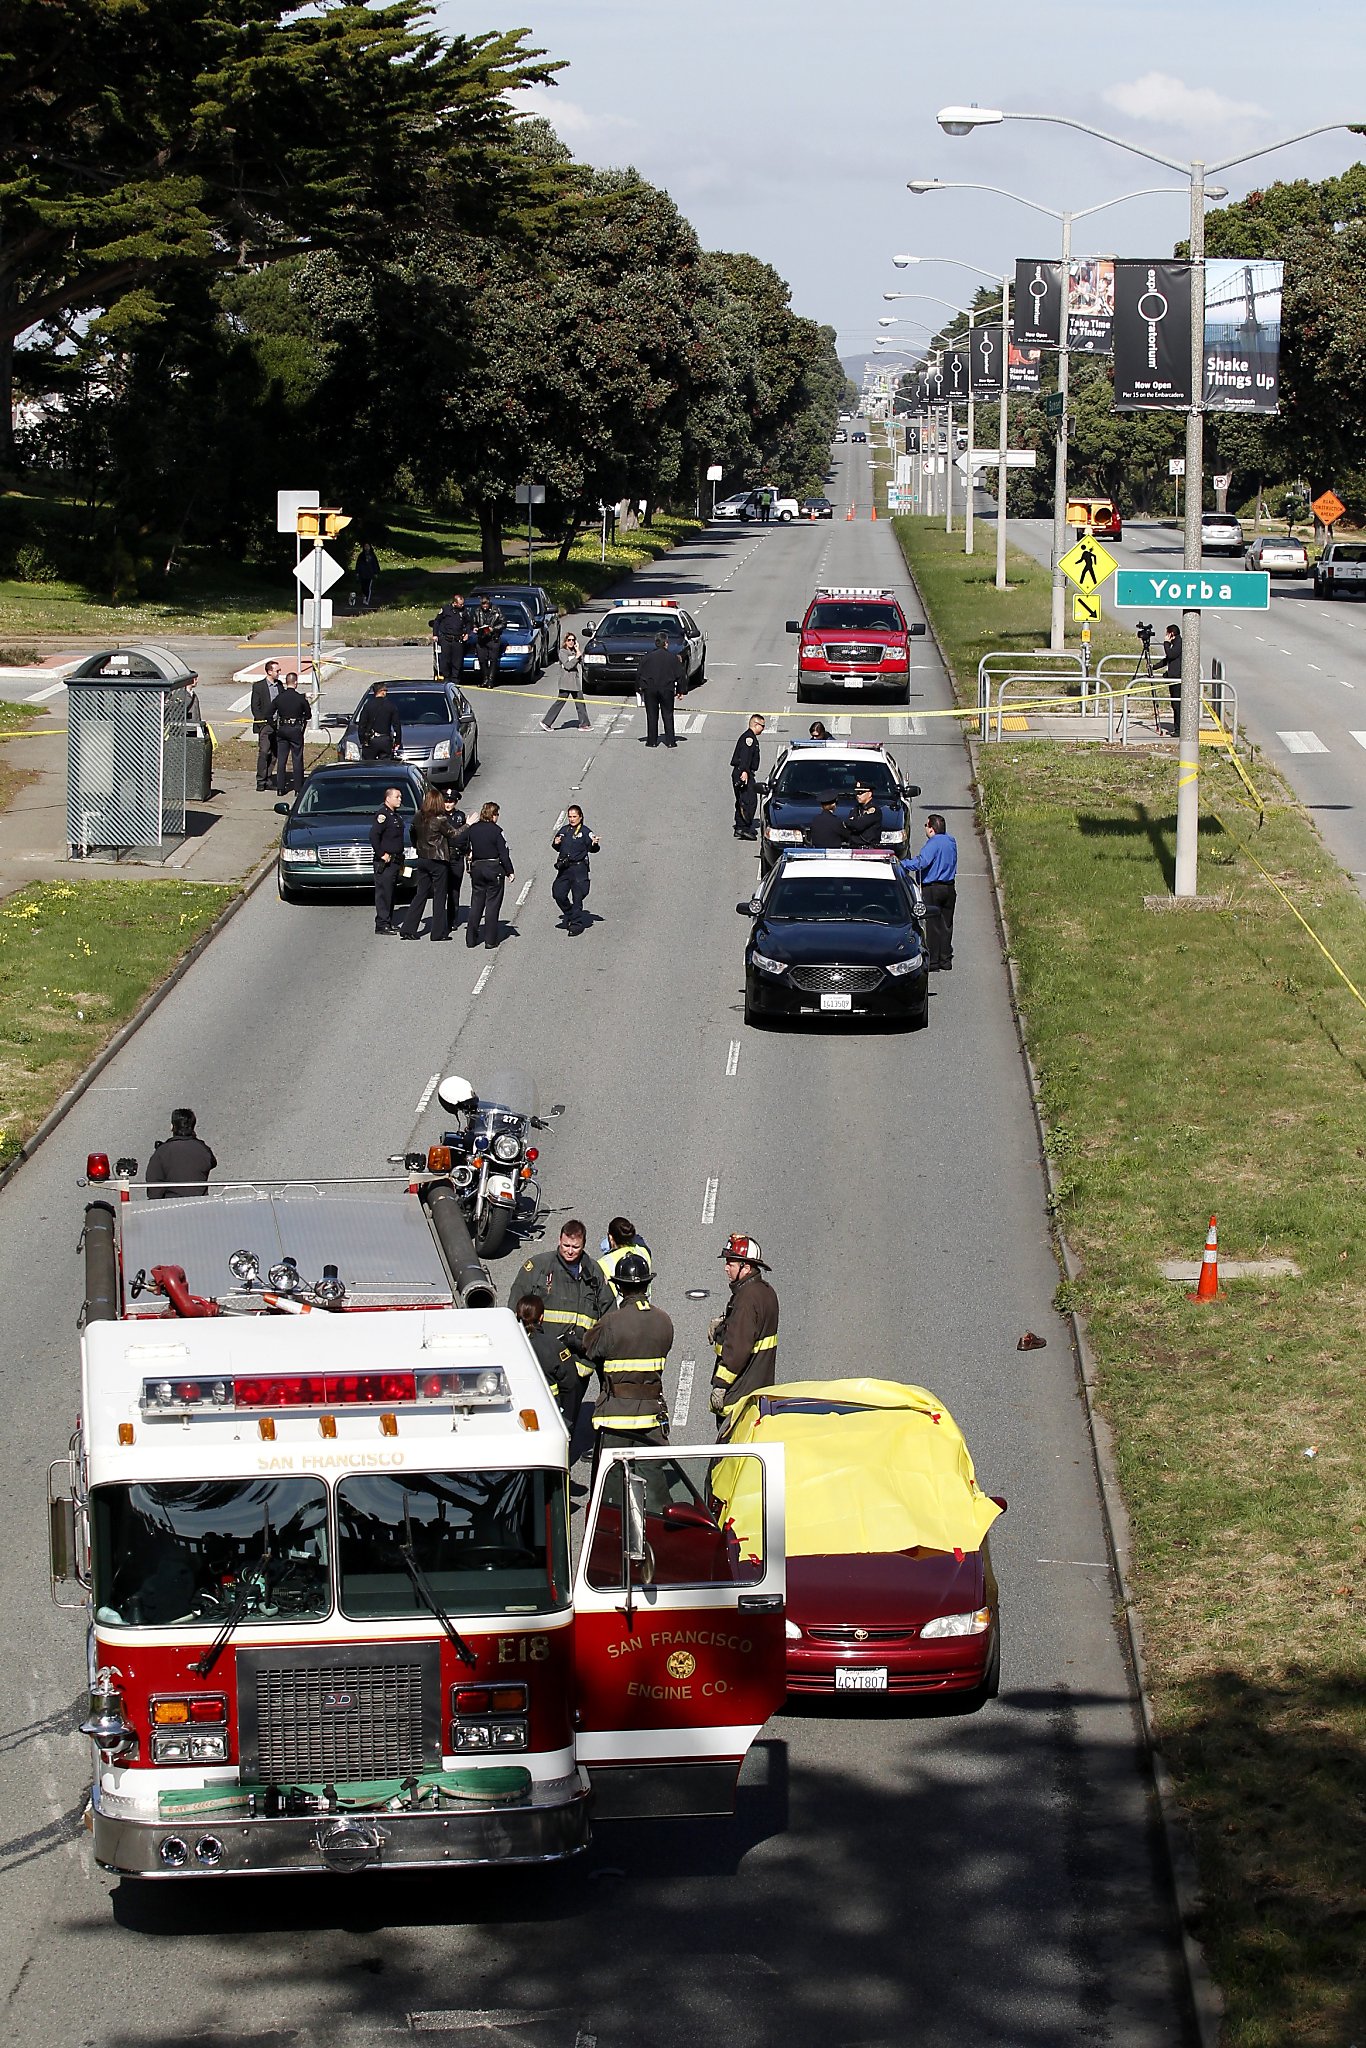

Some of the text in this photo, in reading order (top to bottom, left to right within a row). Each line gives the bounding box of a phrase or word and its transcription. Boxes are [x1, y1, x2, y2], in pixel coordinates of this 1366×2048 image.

[1069, 318, 1111, 328] Take Time
[1138, 269, 1168, 369] exploratorium
[1069, 328, 1106, 338] to Tinker
[1207, 357, 1249, 372] Shake
[1134, 381, 1172, 390] Now Open
[1206, 372, 1275, 390] Things Up
[1149, 579, 1232, 600] Yorba
[502, 1114, 519, 1125] 277
[257, 1451, 405, 1470] SAN FRANCISCO
[497, 1635, 550, 1664] E18
[607, 1630, 753, 1659] SAN FRANCISCO
[626, 1680, 734, 1700] ENGINE CO.
[838, 1676, 885, 1689] 4CYT807
